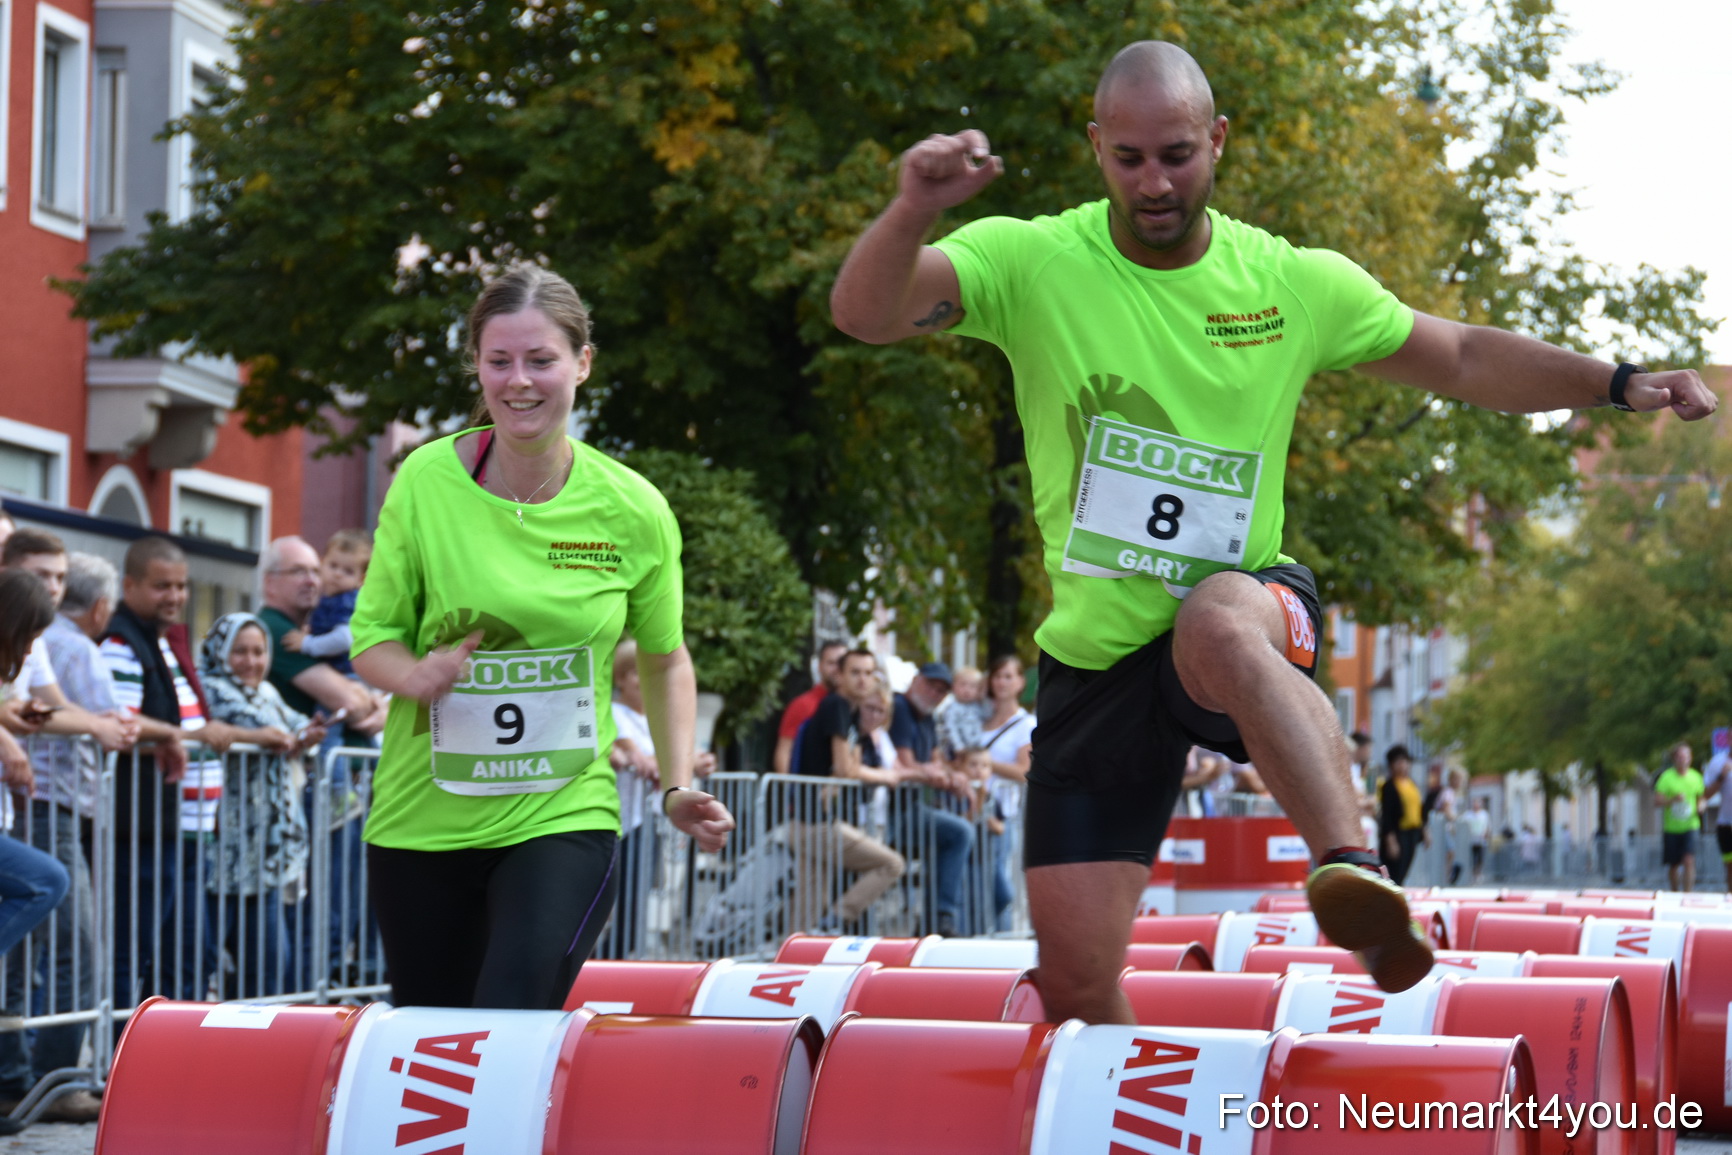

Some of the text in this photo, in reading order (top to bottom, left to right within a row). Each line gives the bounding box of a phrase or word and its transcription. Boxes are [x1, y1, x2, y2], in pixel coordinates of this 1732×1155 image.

[1100, 428, 1246, 492] BOCK
[1147, 494, 1184, 541] 8
[1117, 549, 1192, 581] GARY
[494, 703, 524, 745] 9
[472, 757, 553, 779] ANIKA
